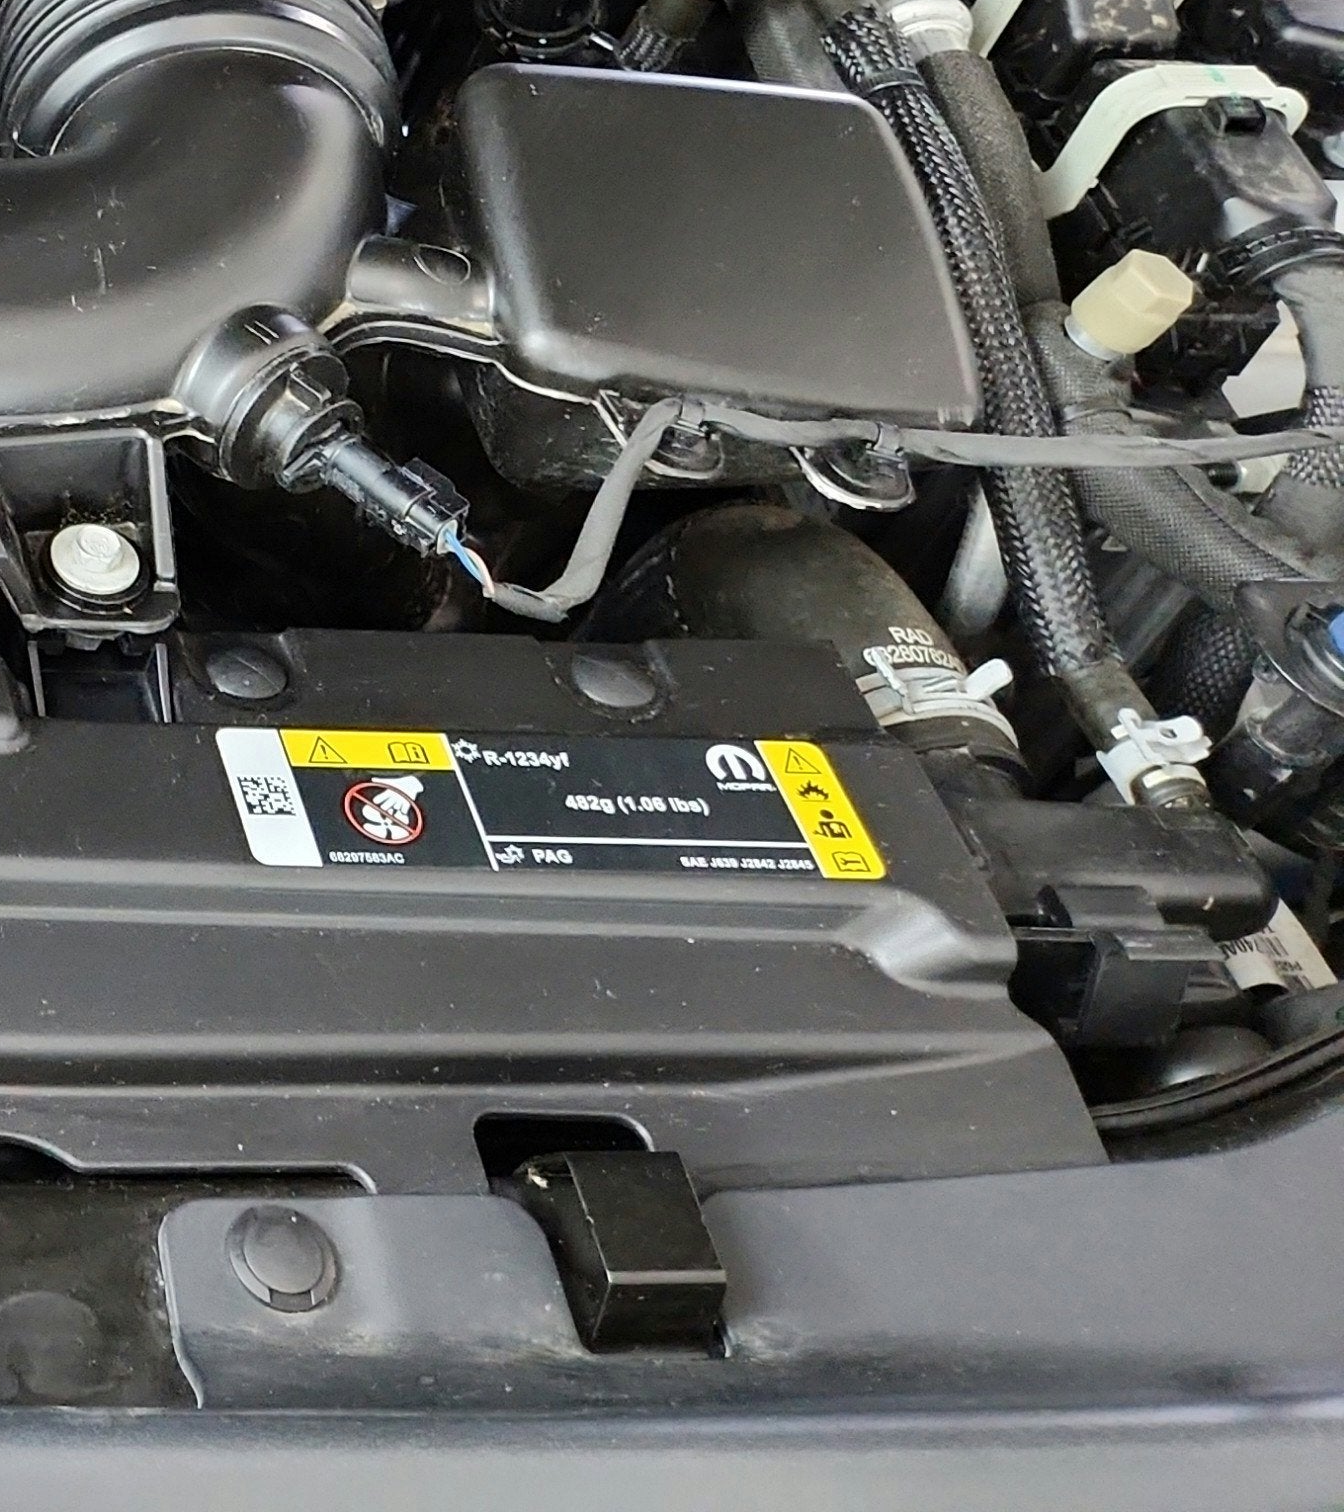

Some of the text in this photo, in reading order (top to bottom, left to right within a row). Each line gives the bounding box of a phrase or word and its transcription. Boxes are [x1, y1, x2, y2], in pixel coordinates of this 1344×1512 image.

[887, 626, 934, 646] RAD
[481, 749, 570, 771] R-1234yf
[716, 781, 776, 792] MOPAR
[564, 794, 710, 817] 482g (1.06 lbs)
[531, 848, 574, 865] PAG
[679, 855, 709, 869] SAE
